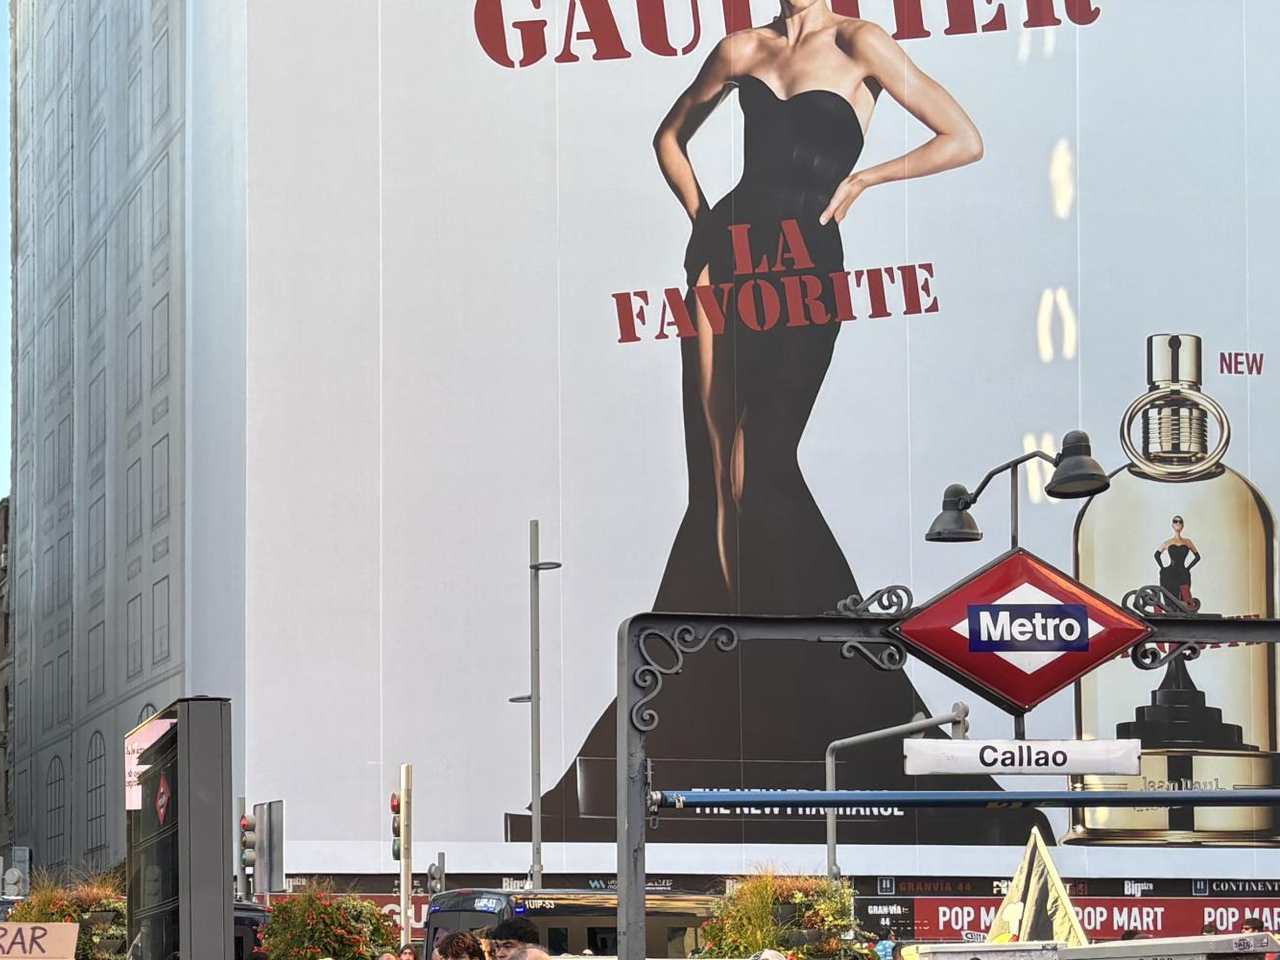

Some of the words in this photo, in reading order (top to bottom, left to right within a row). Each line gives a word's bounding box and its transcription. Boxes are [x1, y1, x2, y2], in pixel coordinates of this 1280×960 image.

[727, 219, 815, 275] LA
[611, 263, 939, 343] FAVORITE
[1219, 352, 1264, 375] NEW
[979, 611, 1081, 642] Metro
[979, 745, 1068, 767] Callao
[957, 882, 972, 891] 44
[880, 917, 890, 926] 44
[938, 906, 975, 930] POP
[1113, 906, 1165, 931] MART
[1204, 907, 1239, 931] POP
